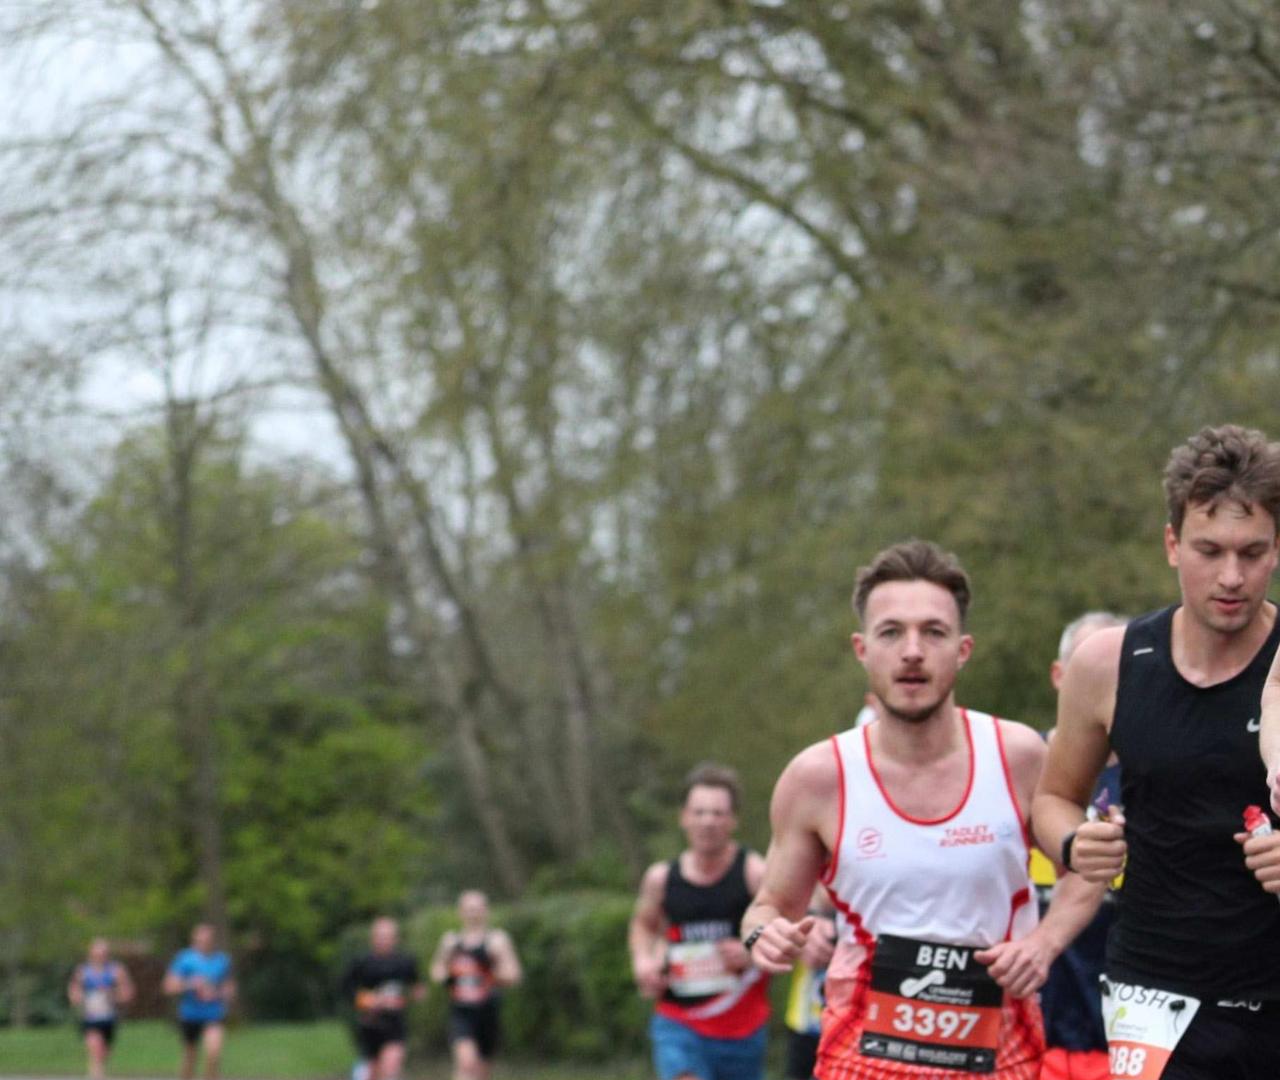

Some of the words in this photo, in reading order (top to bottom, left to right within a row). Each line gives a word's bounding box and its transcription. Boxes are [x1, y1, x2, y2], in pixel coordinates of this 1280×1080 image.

[945, 824, 988, 837] TADLEY
[939, 834, 994, 847] RUNNERS
[916, 945, 969, 971] BEN
[892, 1004, 980, 1040] 3397
